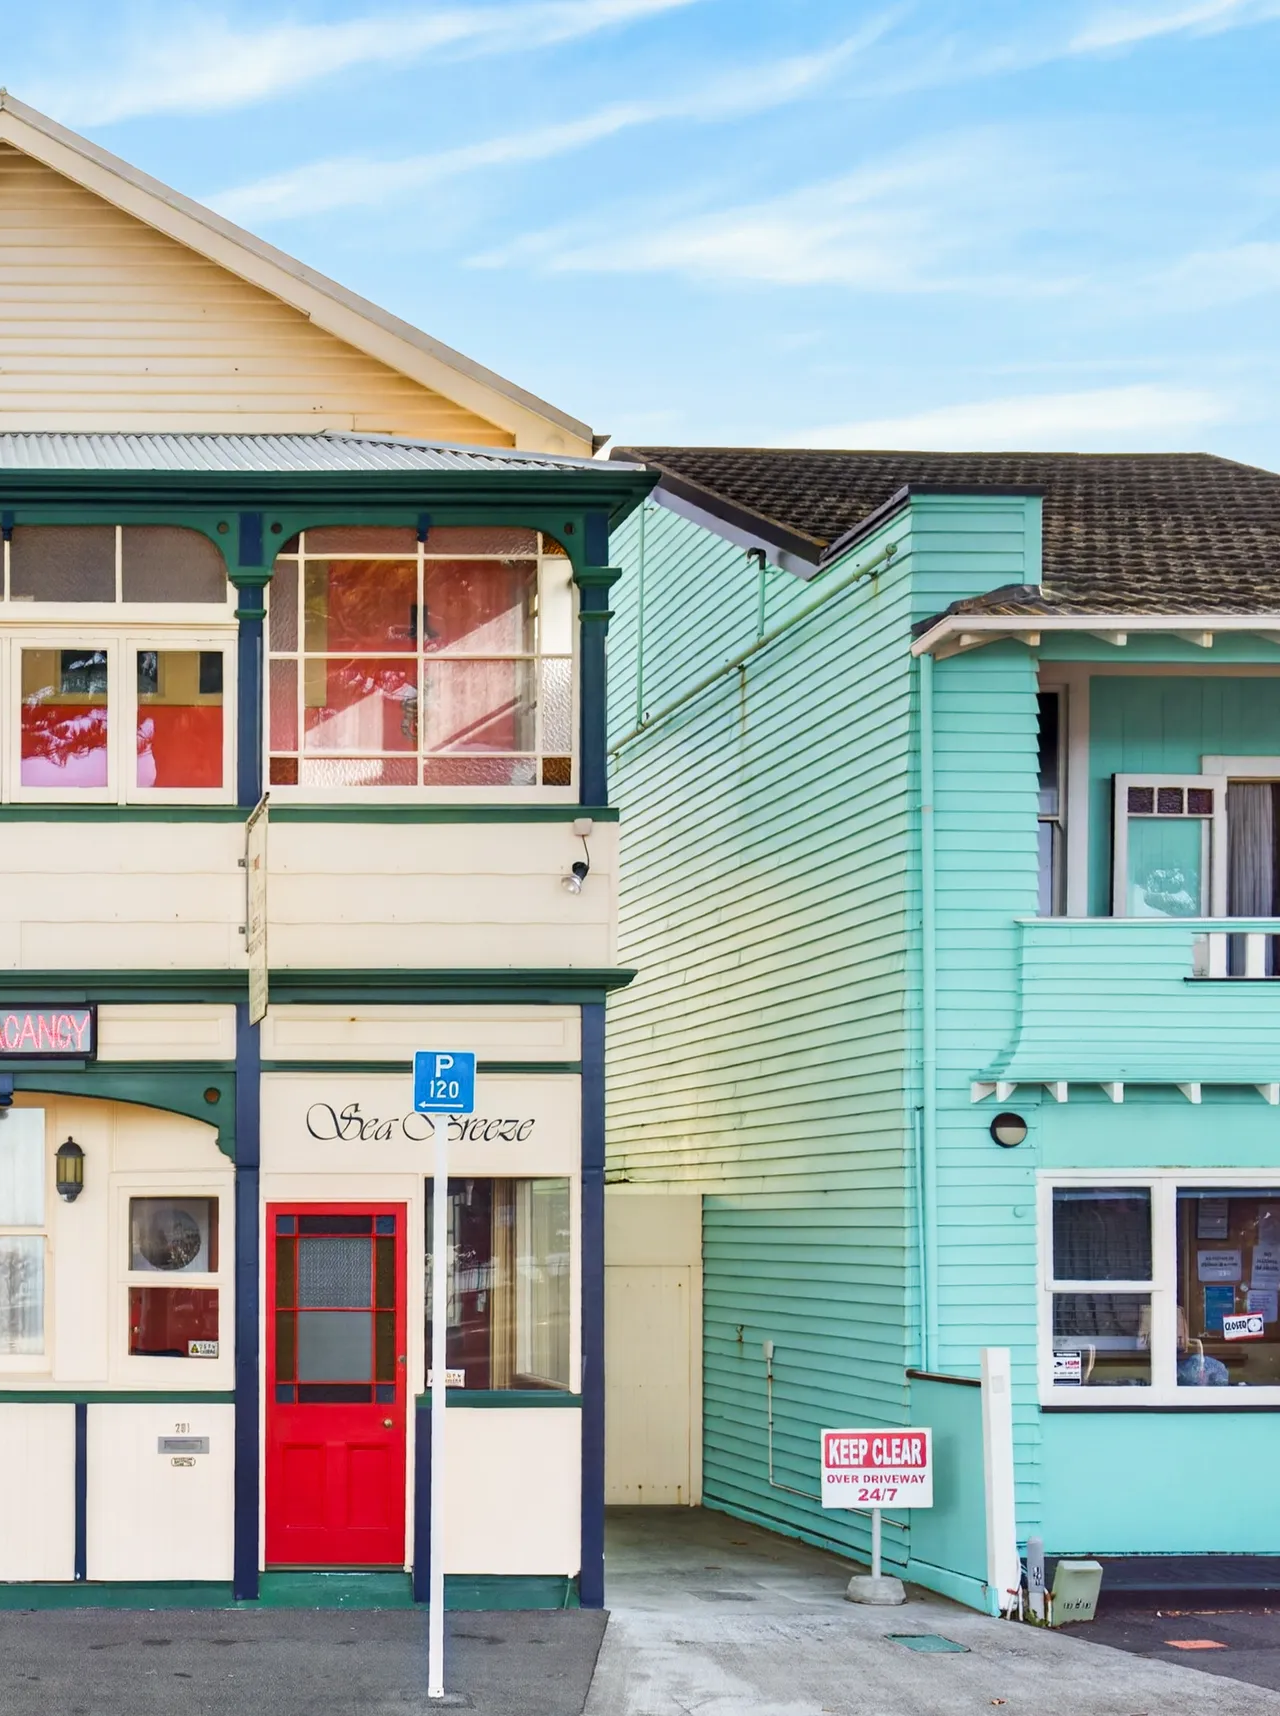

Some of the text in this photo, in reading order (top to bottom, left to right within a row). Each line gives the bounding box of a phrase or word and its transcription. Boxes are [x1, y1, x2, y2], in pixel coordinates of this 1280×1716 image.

[435, 1054, 454, 1078] P
[429, 1080, 459, 1098] 120
[306, 1103, 399, 1141] Sea
[828, 1437, 923, 1466] KEEP CLEAR
[826, 1474, 926, 1484] OVER DRIVEWAY
[857, 1487, 898, 1502] 24/7
